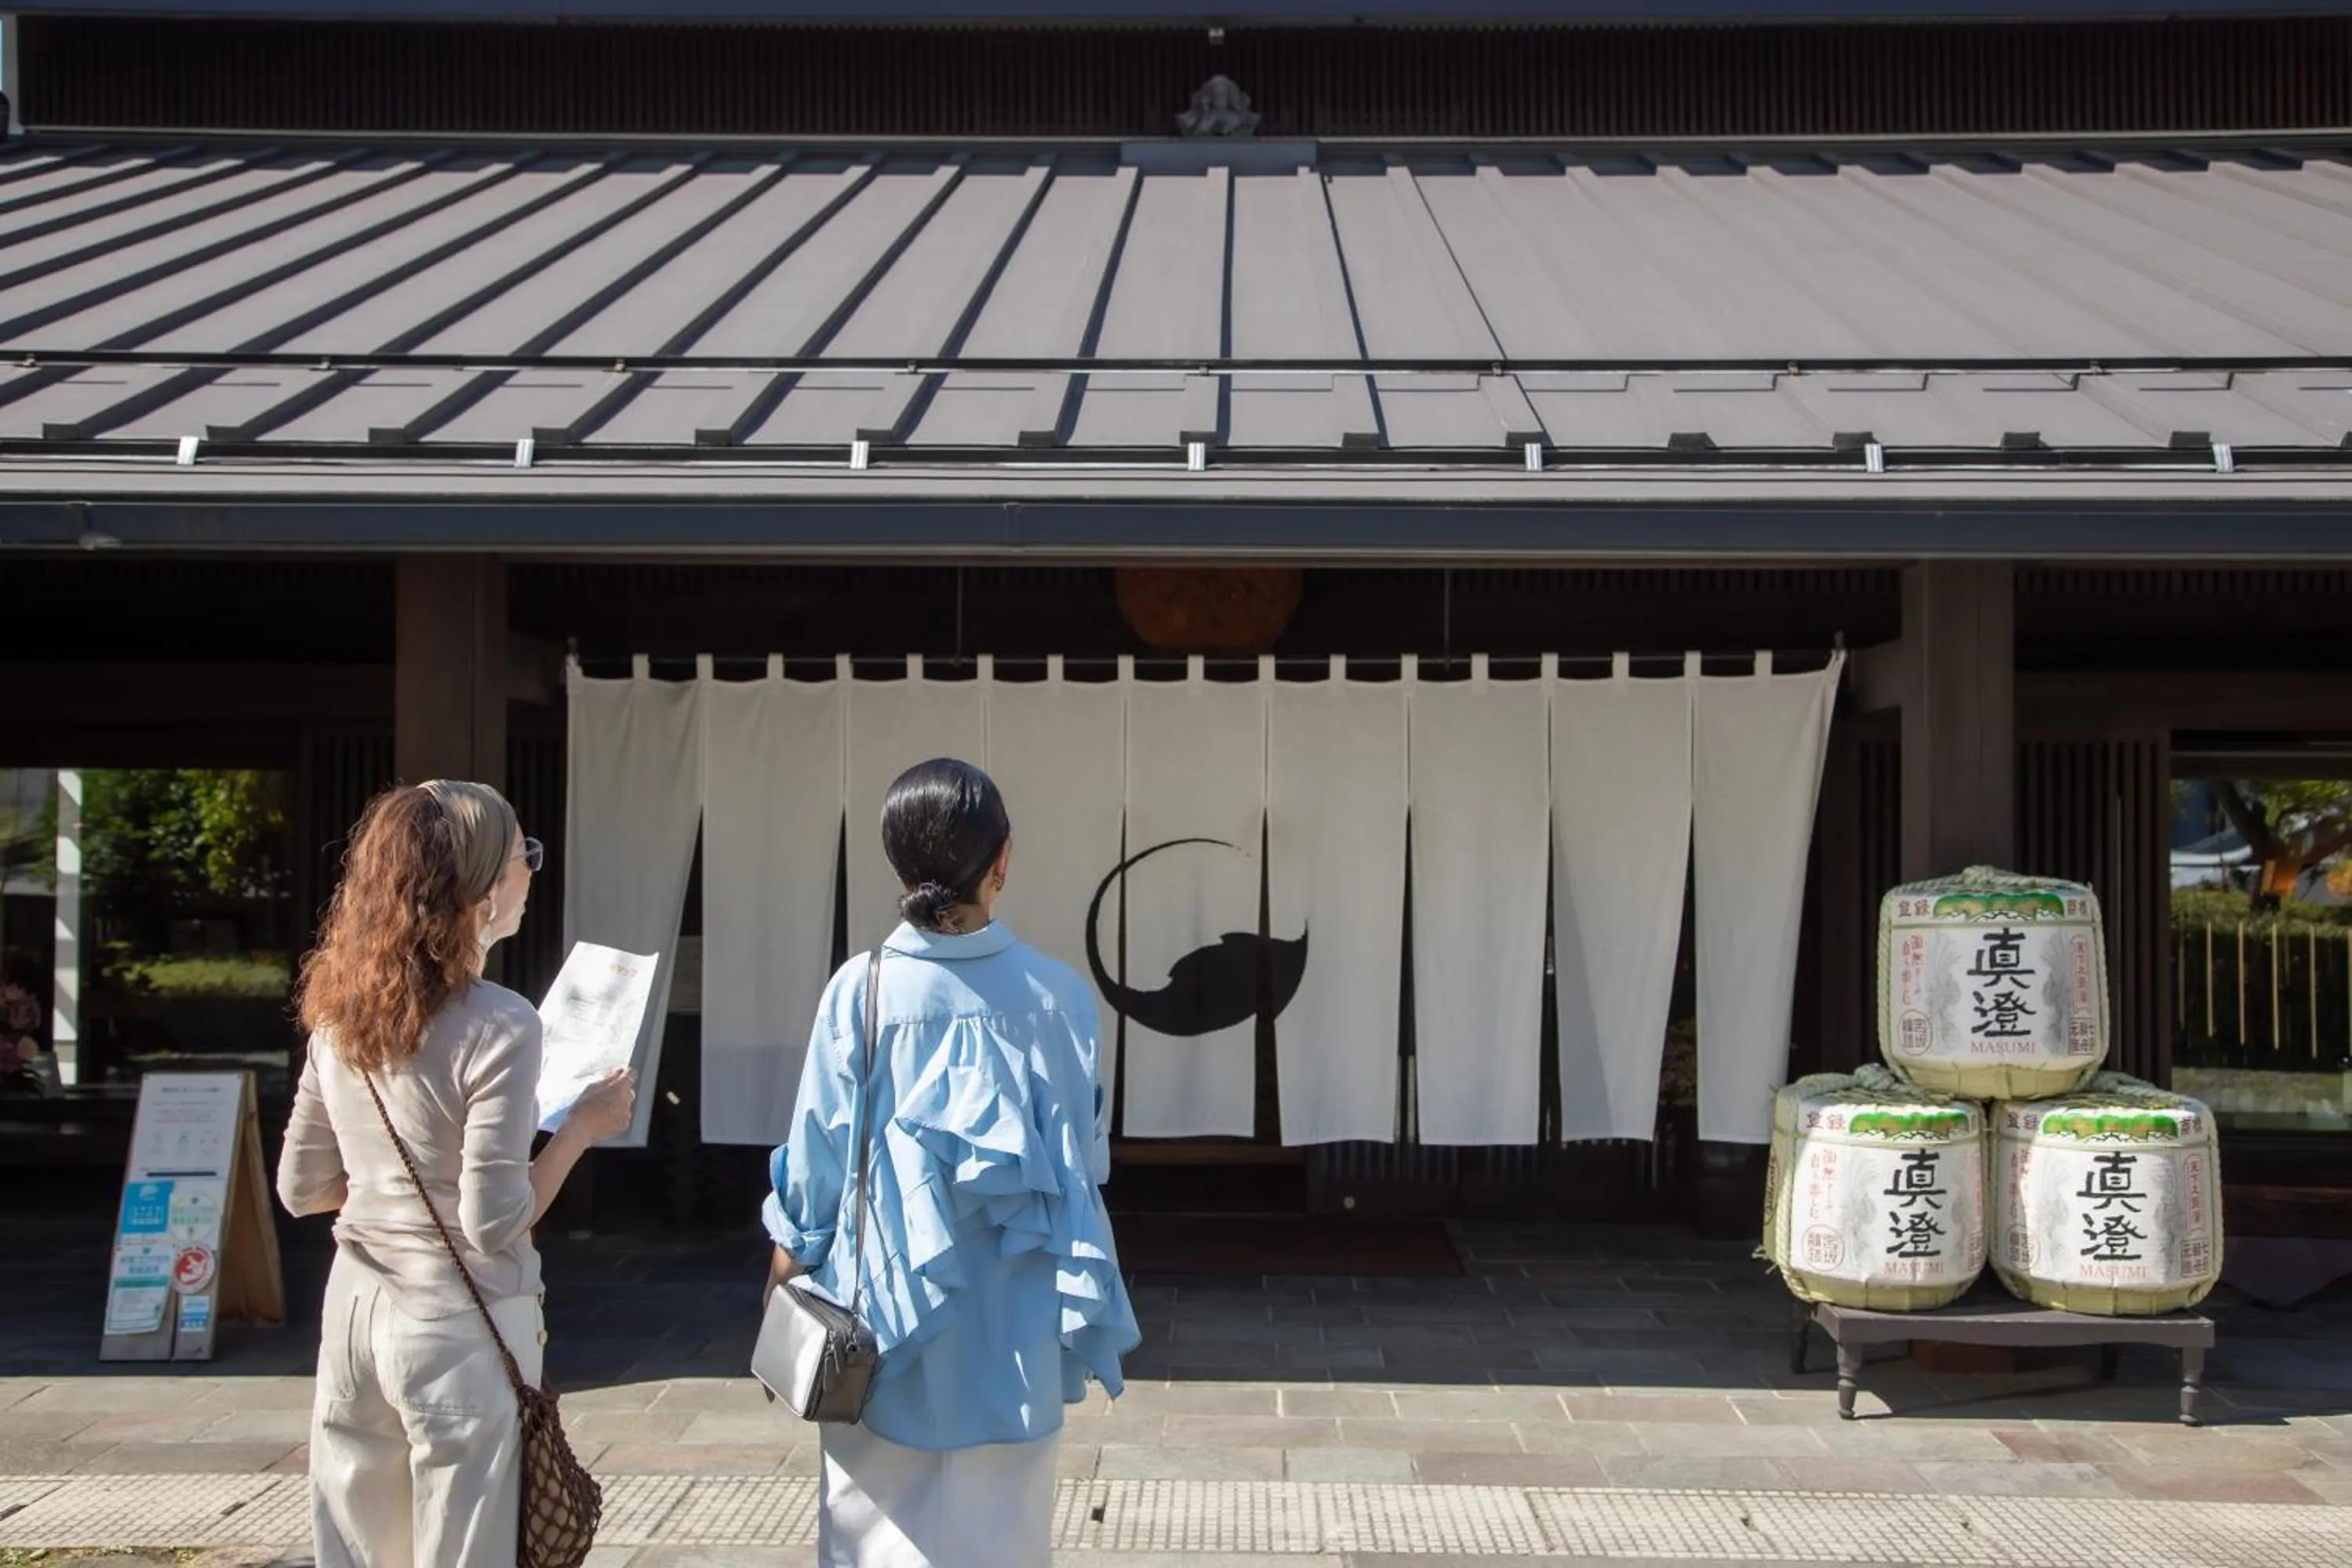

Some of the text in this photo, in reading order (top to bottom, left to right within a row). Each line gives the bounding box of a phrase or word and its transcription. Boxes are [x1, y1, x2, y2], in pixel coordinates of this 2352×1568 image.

[1971, 1041, 2036, 1054] MASUMI
[1886, 1262, 1944, 1274] MASUMI
[2080, 1265, 2147, 1278] MASUMI
